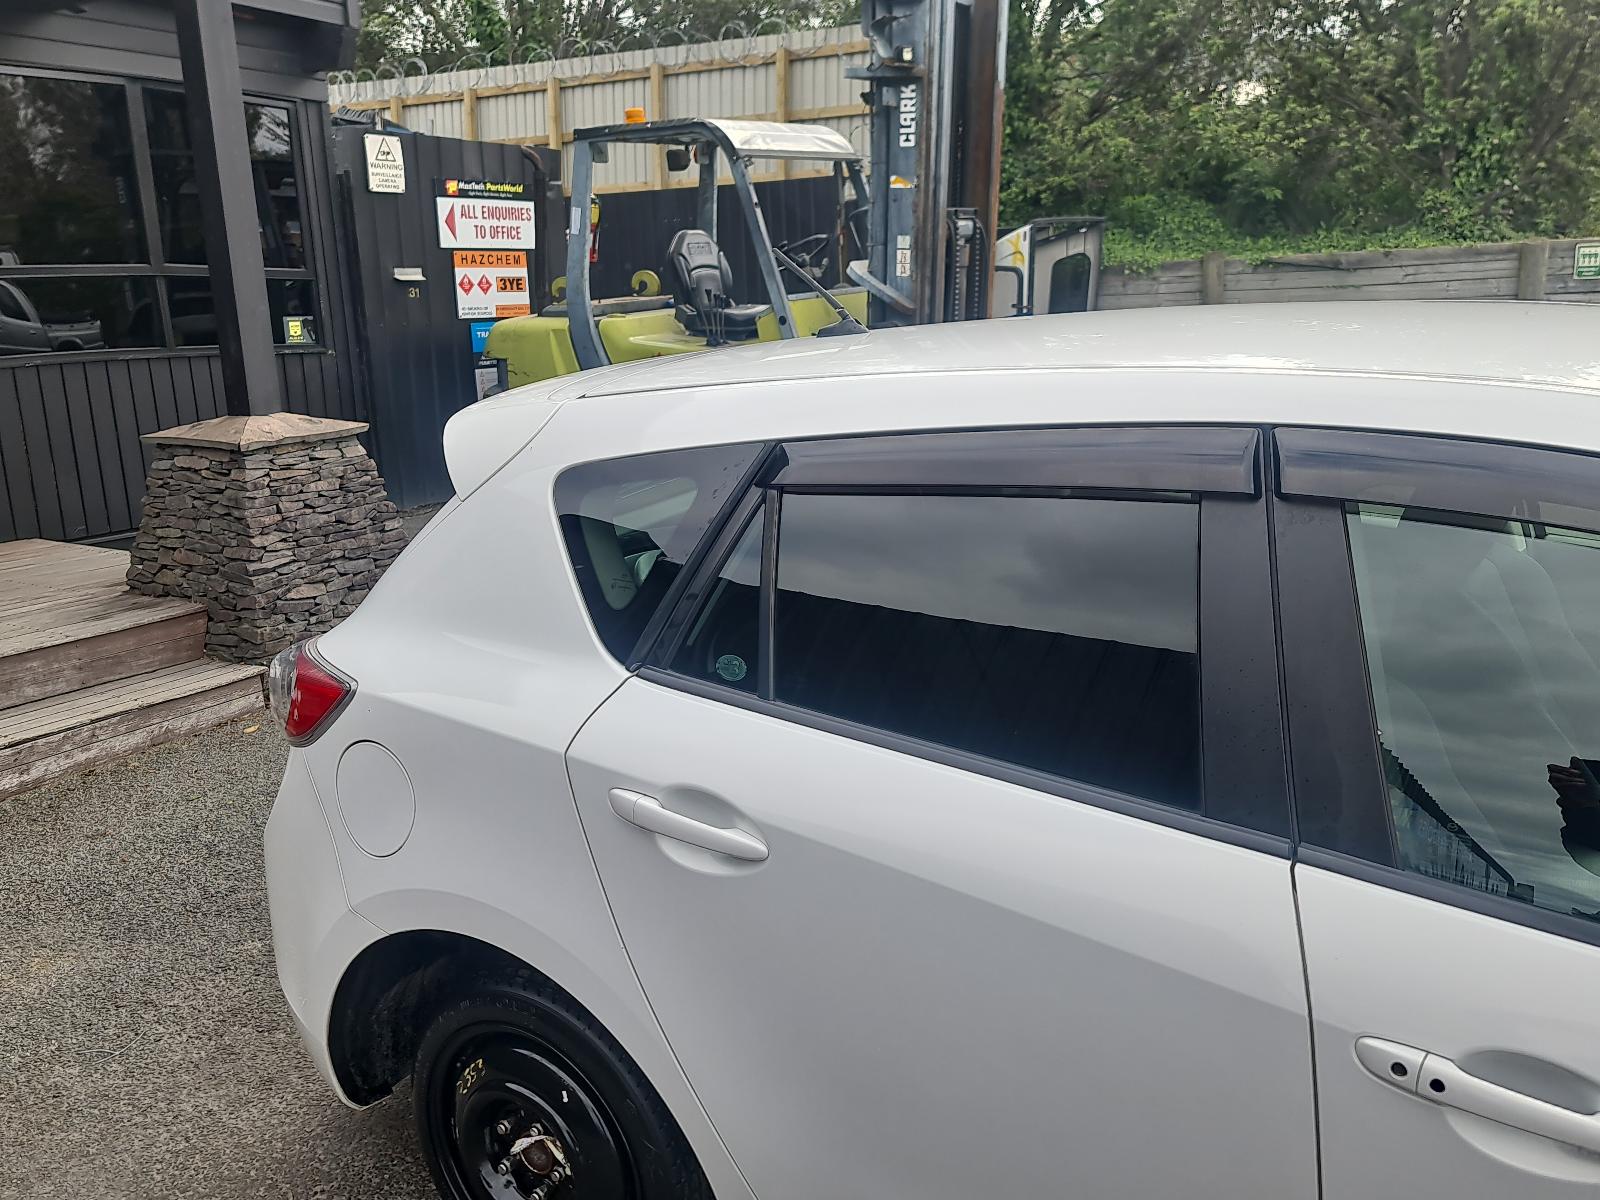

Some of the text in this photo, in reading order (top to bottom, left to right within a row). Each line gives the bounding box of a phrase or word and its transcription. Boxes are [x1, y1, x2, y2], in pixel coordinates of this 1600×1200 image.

[899, 84, 916, 148] CLARK
[370, 162, 403, 171] WARNING
[460, 204, 532, 222] ALL ENQUIRIES
[473, 224, 522, 240] TO OFFICE
[460, 254, 521, 265] HAZCHEM
[499, 278, 524, 291] 3YE
[408, 287, 420, 298] 31
